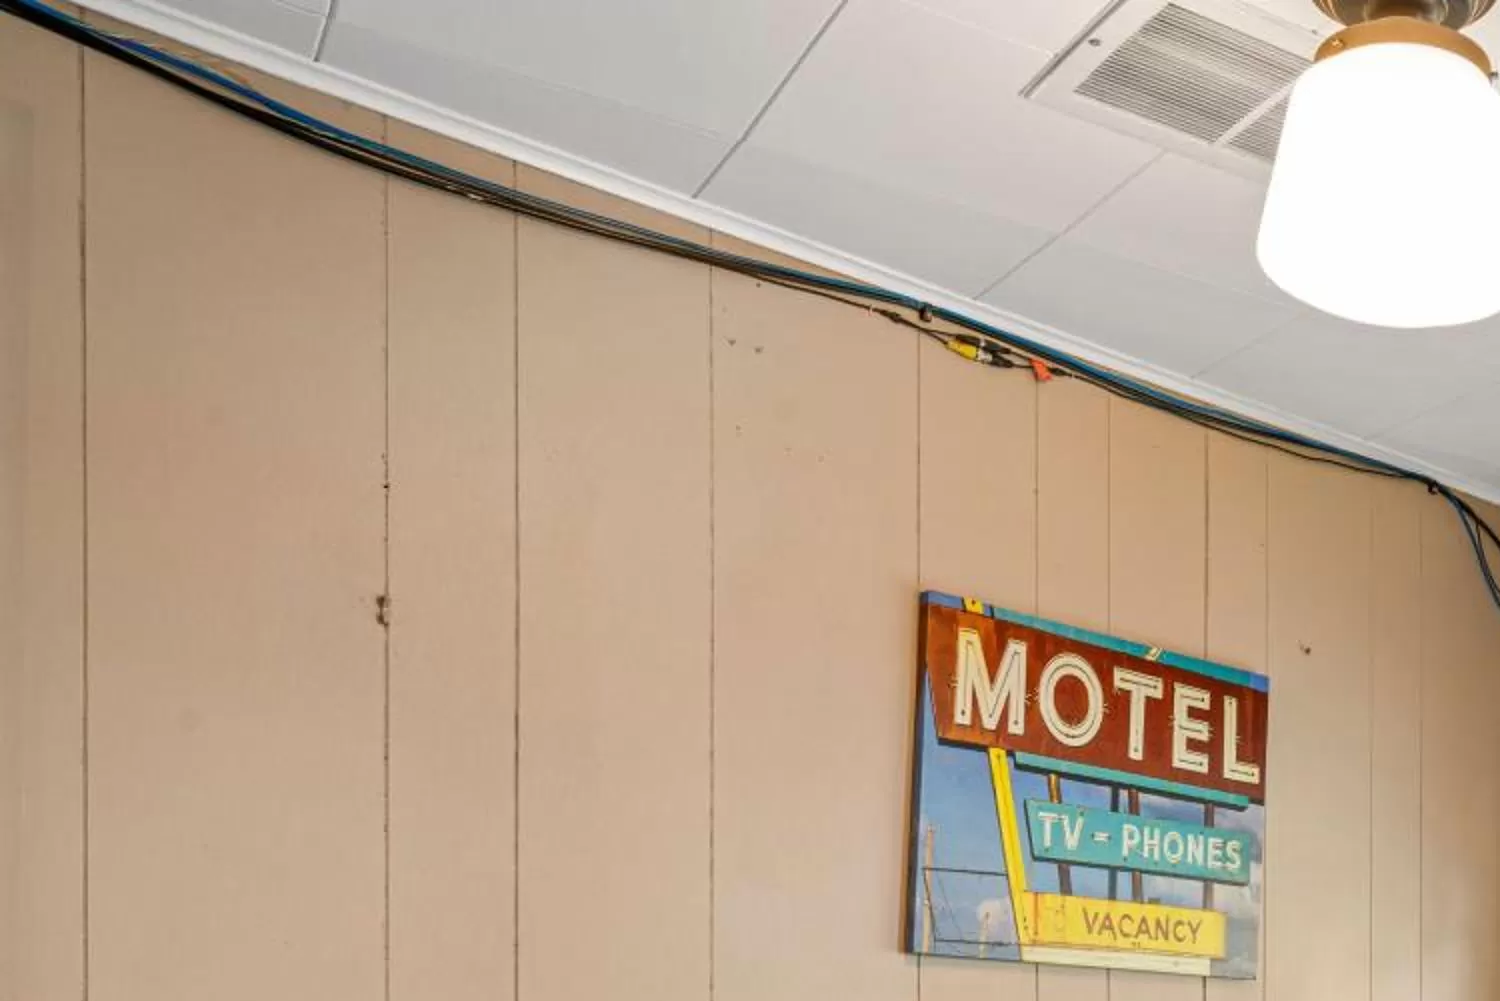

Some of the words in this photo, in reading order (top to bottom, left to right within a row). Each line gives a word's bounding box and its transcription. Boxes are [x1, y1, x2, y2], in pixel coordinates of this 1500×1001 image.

[954, 627, 1260, 785] MOTEL
[1038, 811, 1085, 851] TV
[1121, 823, 1242, 871] PHONES
[1082, 907, 1203, 944] VACANCY
